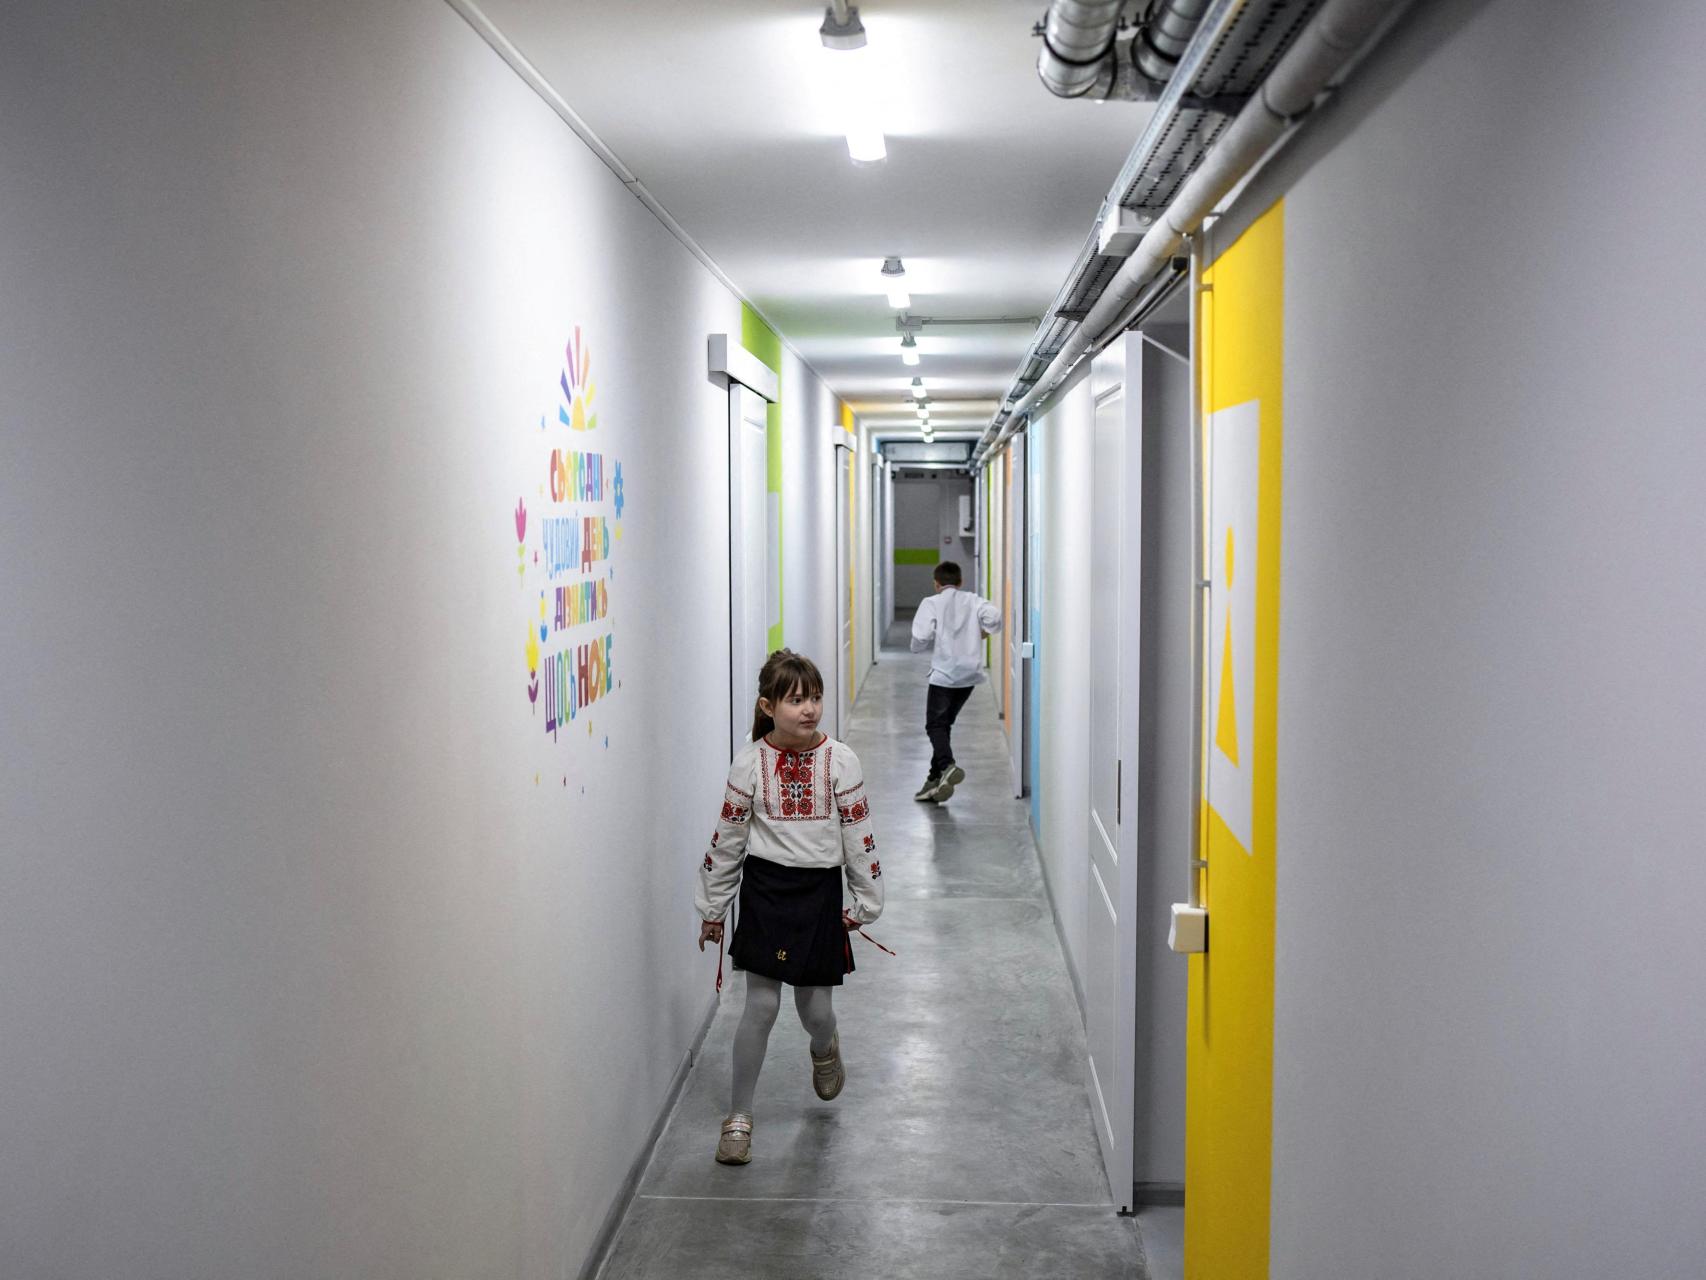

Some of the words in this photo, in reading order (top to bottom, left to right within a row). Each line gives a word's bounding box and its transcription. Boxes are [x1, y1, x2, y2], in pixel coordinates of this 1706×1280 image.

[550, 448, 604, 503] СЬОГОДНІ
[542, 510, 580, 580] ЧУДОВИЙ
[582, 516, 609, 574] ДЕНЬ
[554, 577, 608, 632] ДІЗНАТИСЬ
[544, 647, 577, 744] ЩОСЬ
[577, 633, 613, 709] НОВЕ
